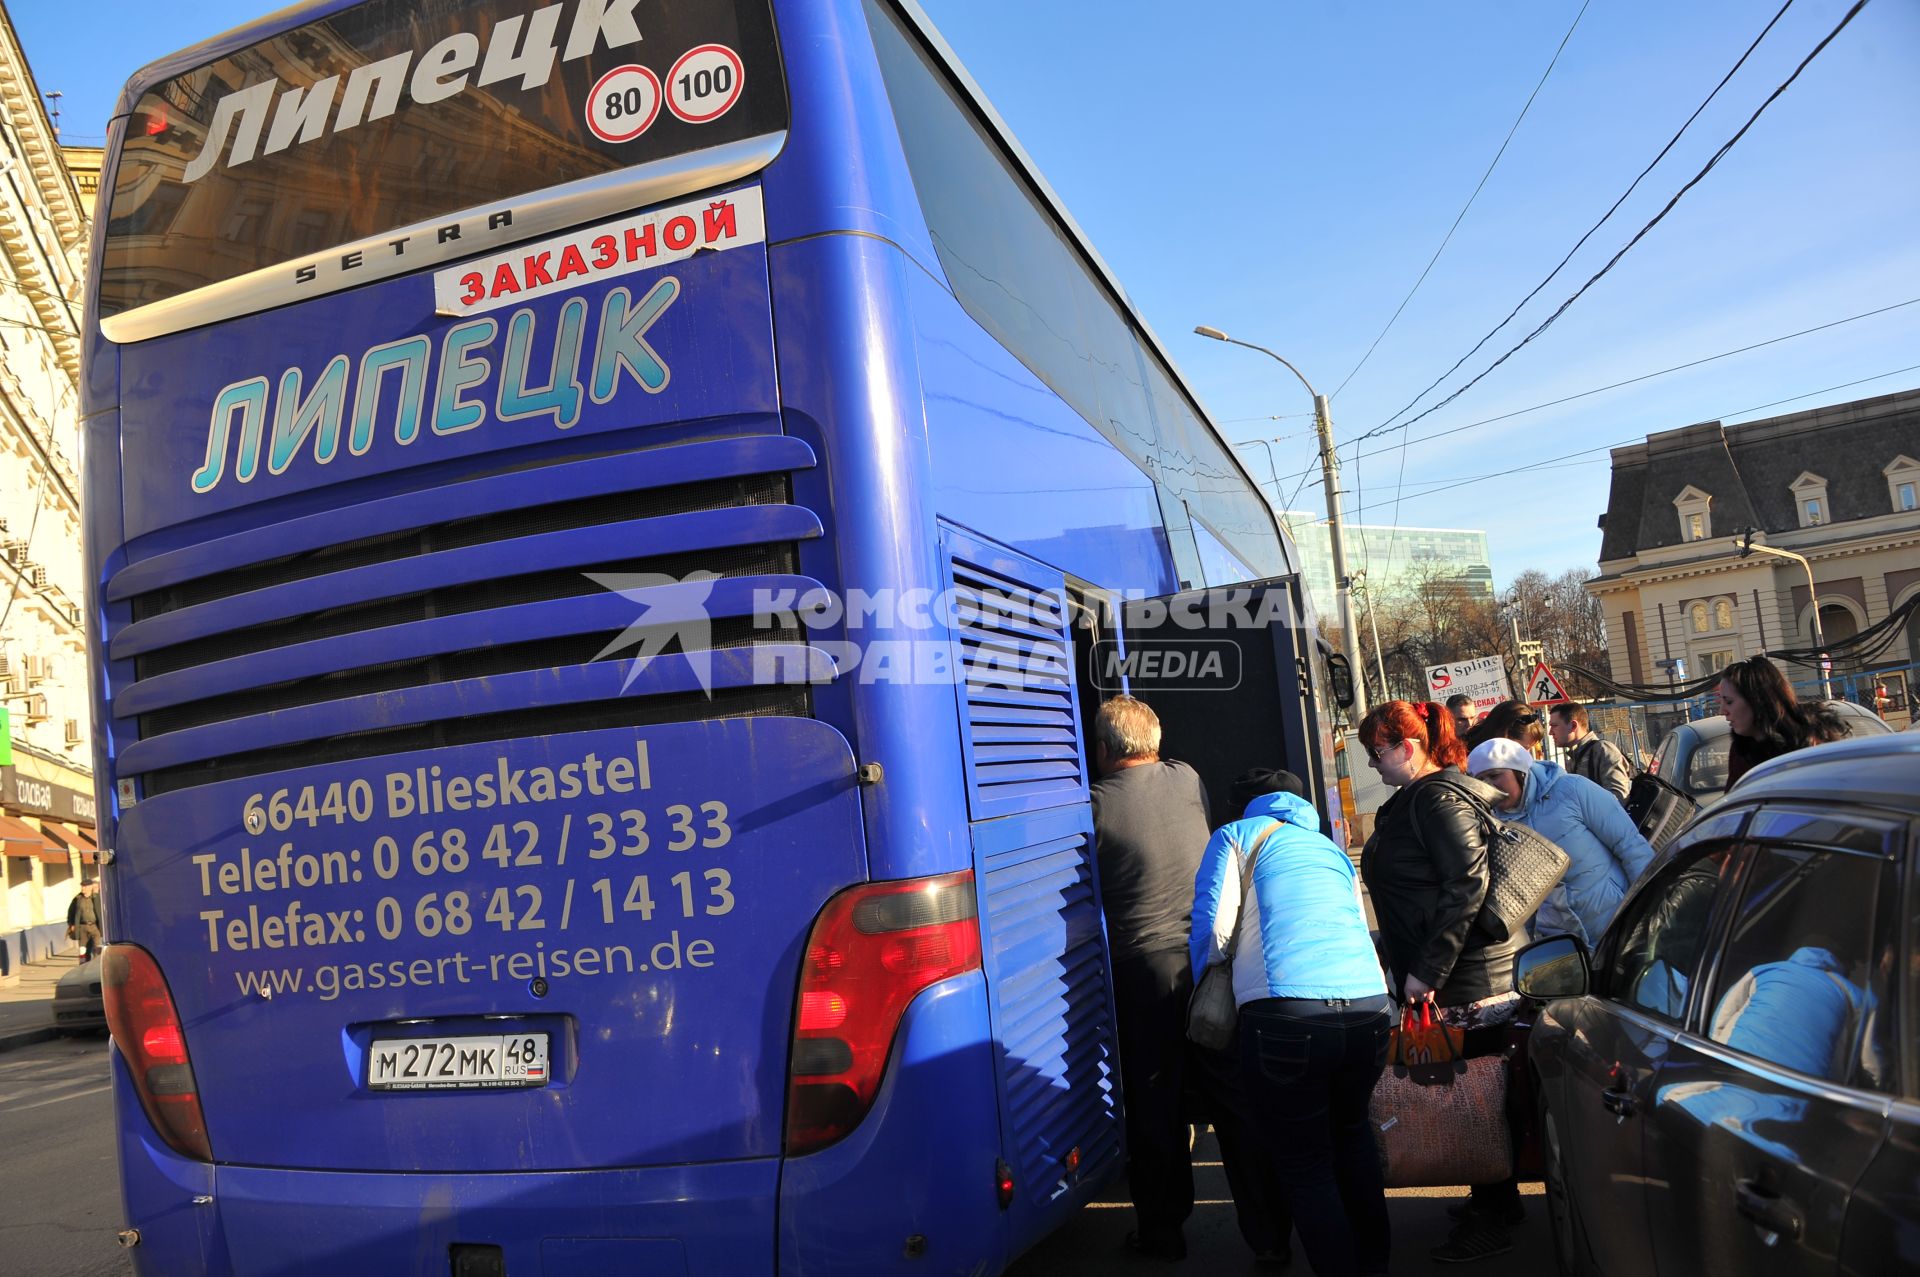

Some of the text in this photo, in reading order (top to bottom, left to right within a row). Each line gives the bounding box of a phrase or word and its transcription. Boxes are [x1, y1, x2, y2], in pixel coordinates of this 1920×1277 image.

[182, 0, 643, 183] Липецк
[604, 86, 643, 121] 80
[678, 67, 733, 102] 100
[295, 208, 514, 285] SETRA
[459, 200, 738, 307] ЗАКАЗНОЙ
[191, 276, 680, 494] ЛИПЕЦК
[1454, 657, 1498, 677] Spline
[243, 740, 651, 836] 66440 Blieskastel
[192, 801, 732, 896] Telefon: 0 68 42 / 33 33
[200, 868, 735, 952] Telefax: 0 68 42 / 14 13
[235, 930, 715, 1001] ww.gassert-reisen.de
[504, 1066, 526, 1075] RUS
[507, 1038, 536, 1064] 48
